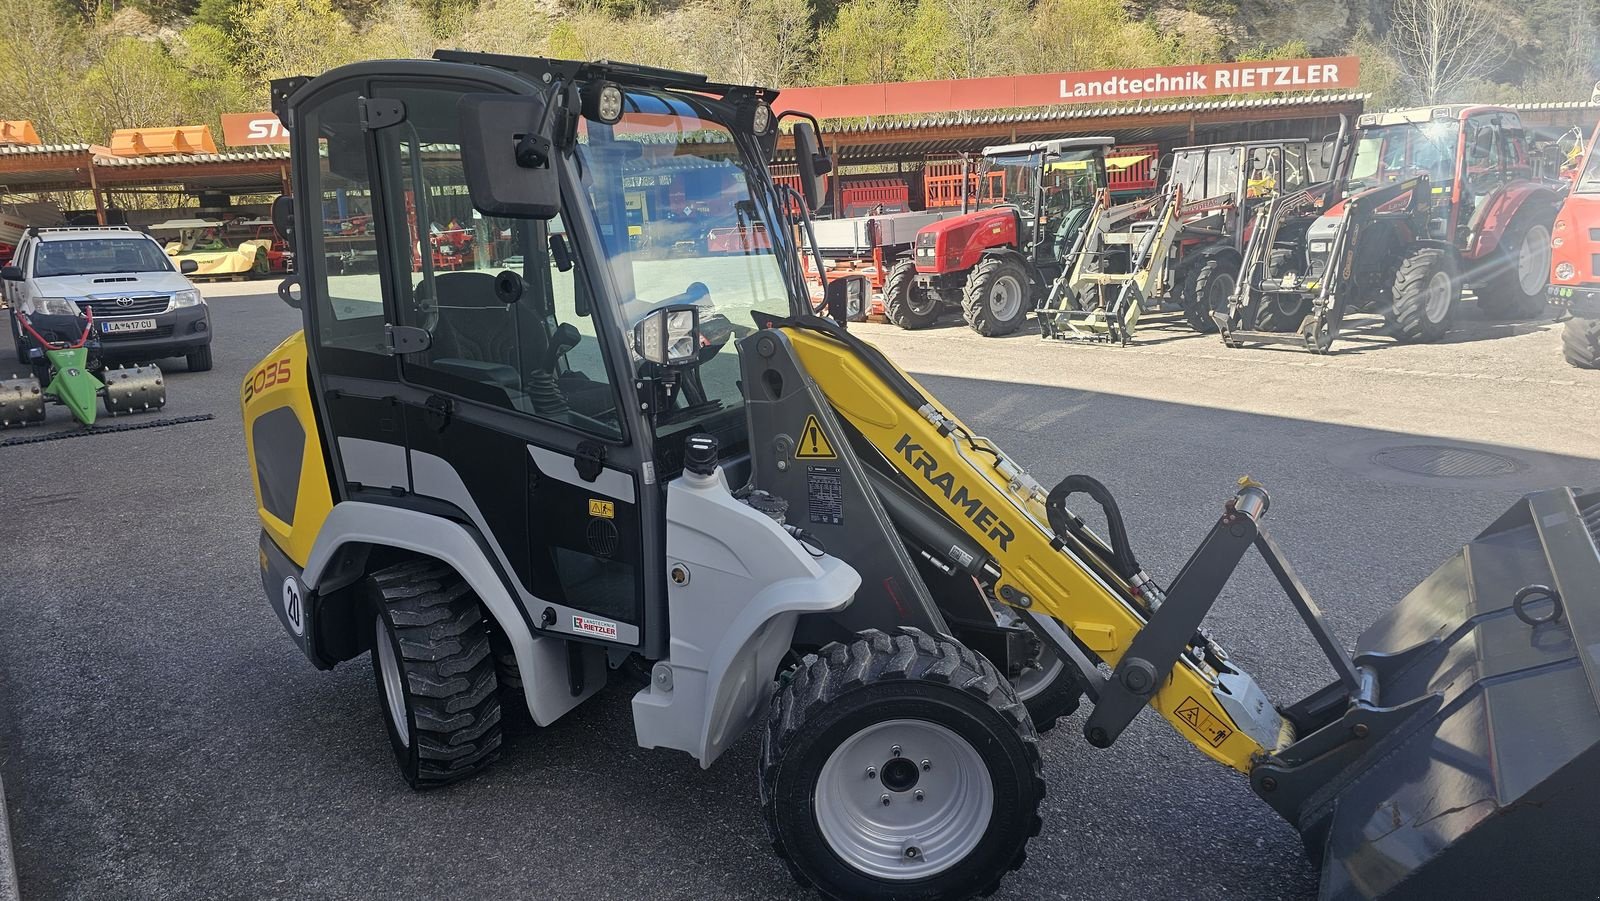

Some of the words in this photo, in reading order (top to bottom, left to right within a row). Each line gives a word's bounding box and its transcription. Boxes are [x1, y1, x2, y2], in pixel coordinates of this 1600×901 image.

[1059, 71, 1207, 98] Landtechnik
[1214, 64, 1339, 89] RIETZLER
[109, 323, 120, 331] LA
[125, 321, 139, 329] 417
[141, 320, 151, 329] CU
[244, 358, 291, 404] 5035
[894, 433, 1015, 552] KRAMER
[287, 585, 300, 627] 20
[584, 624, 615, 635] RIETZLER
